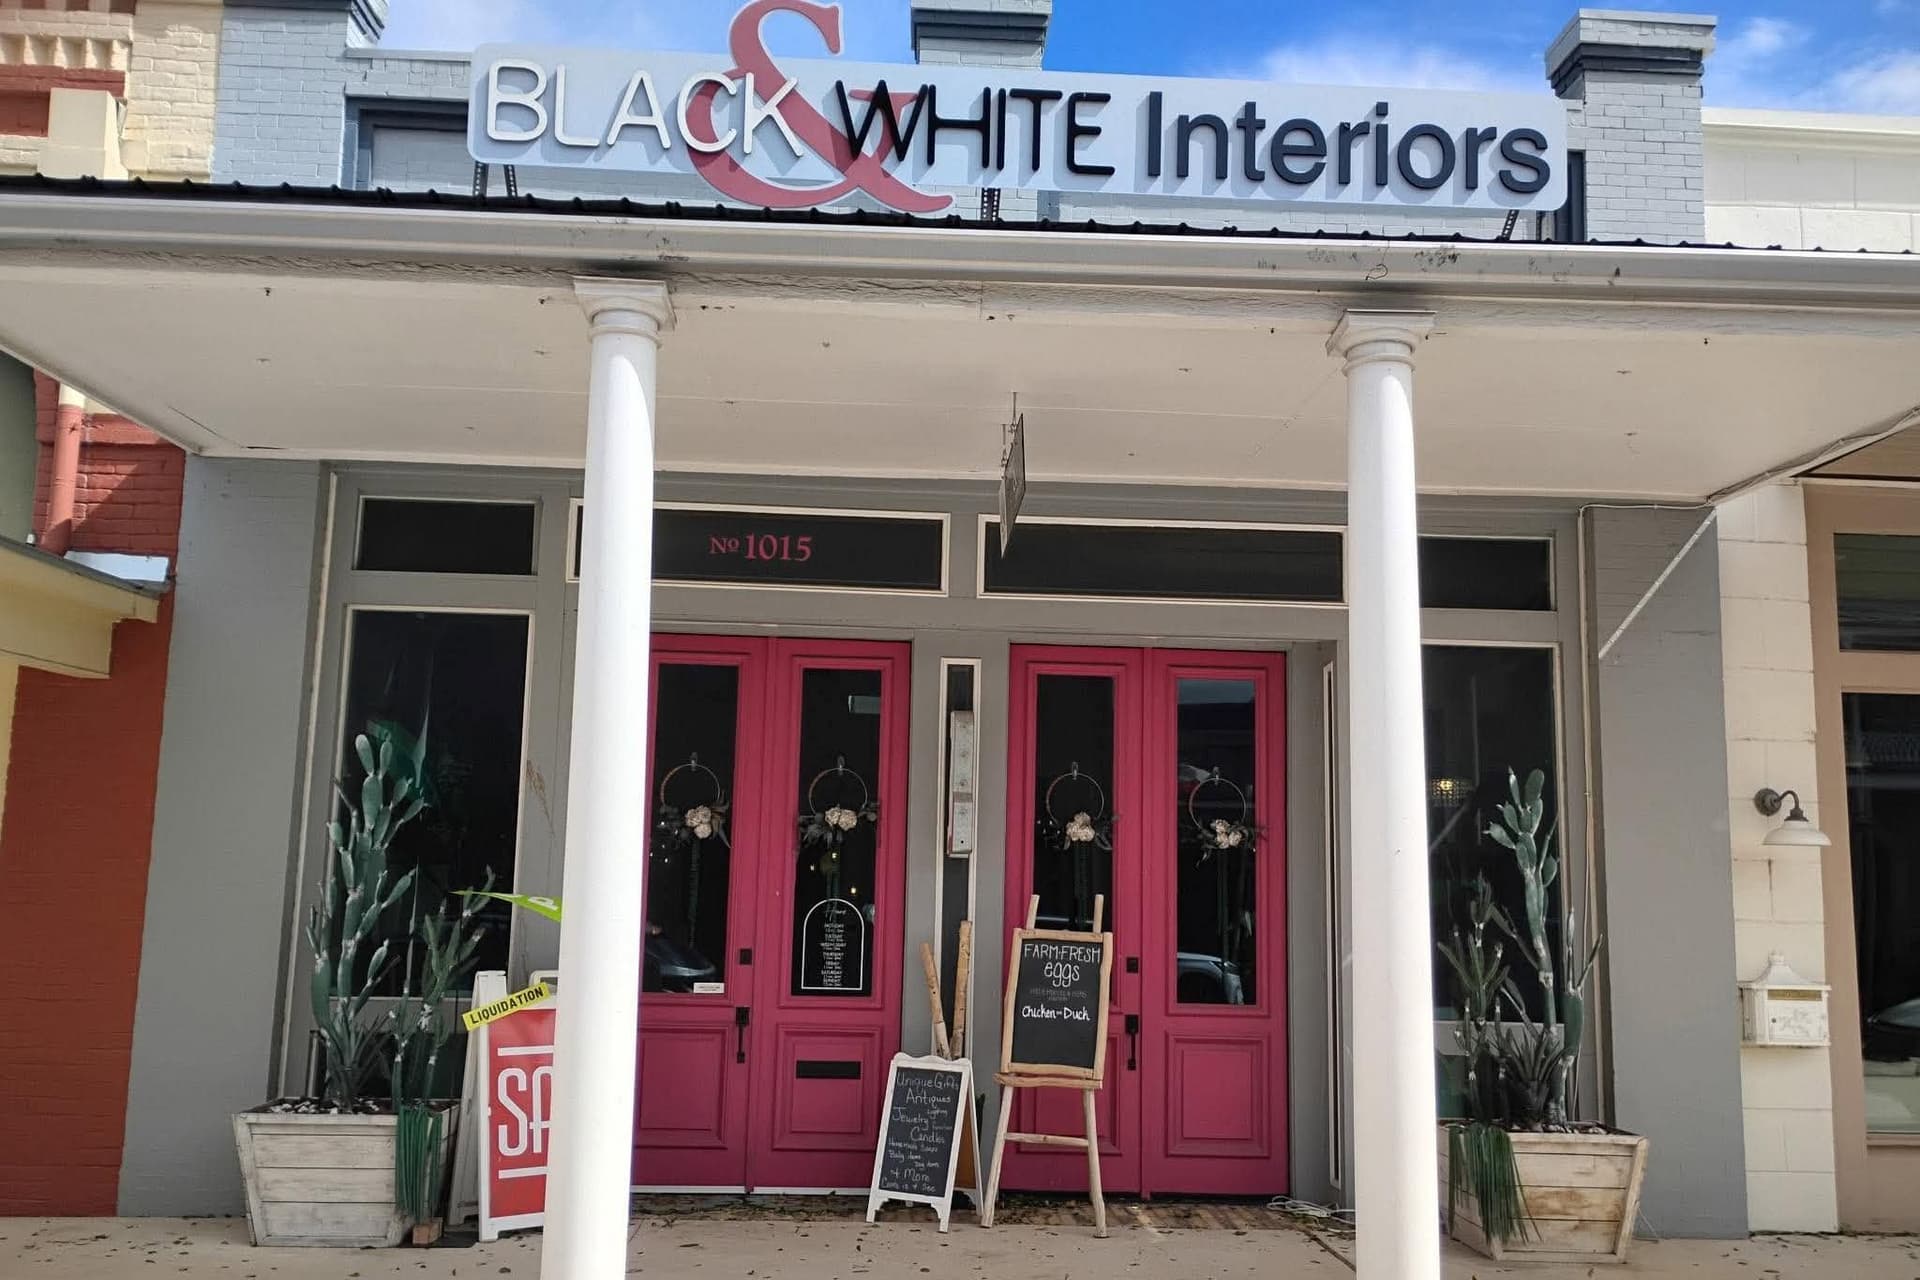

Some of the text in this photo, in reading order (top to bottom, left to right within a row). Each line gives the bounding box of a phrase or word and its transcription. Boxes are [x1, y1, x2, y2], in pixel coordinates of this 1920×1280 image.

[486, 0, 1551, 213] BLACK & WHITE Interiors
[744, 533, 813, 562] 1015
[471, 986, 544, 1025] LIQUIDATION
[906, 1087, 952, 1109] Antiques
